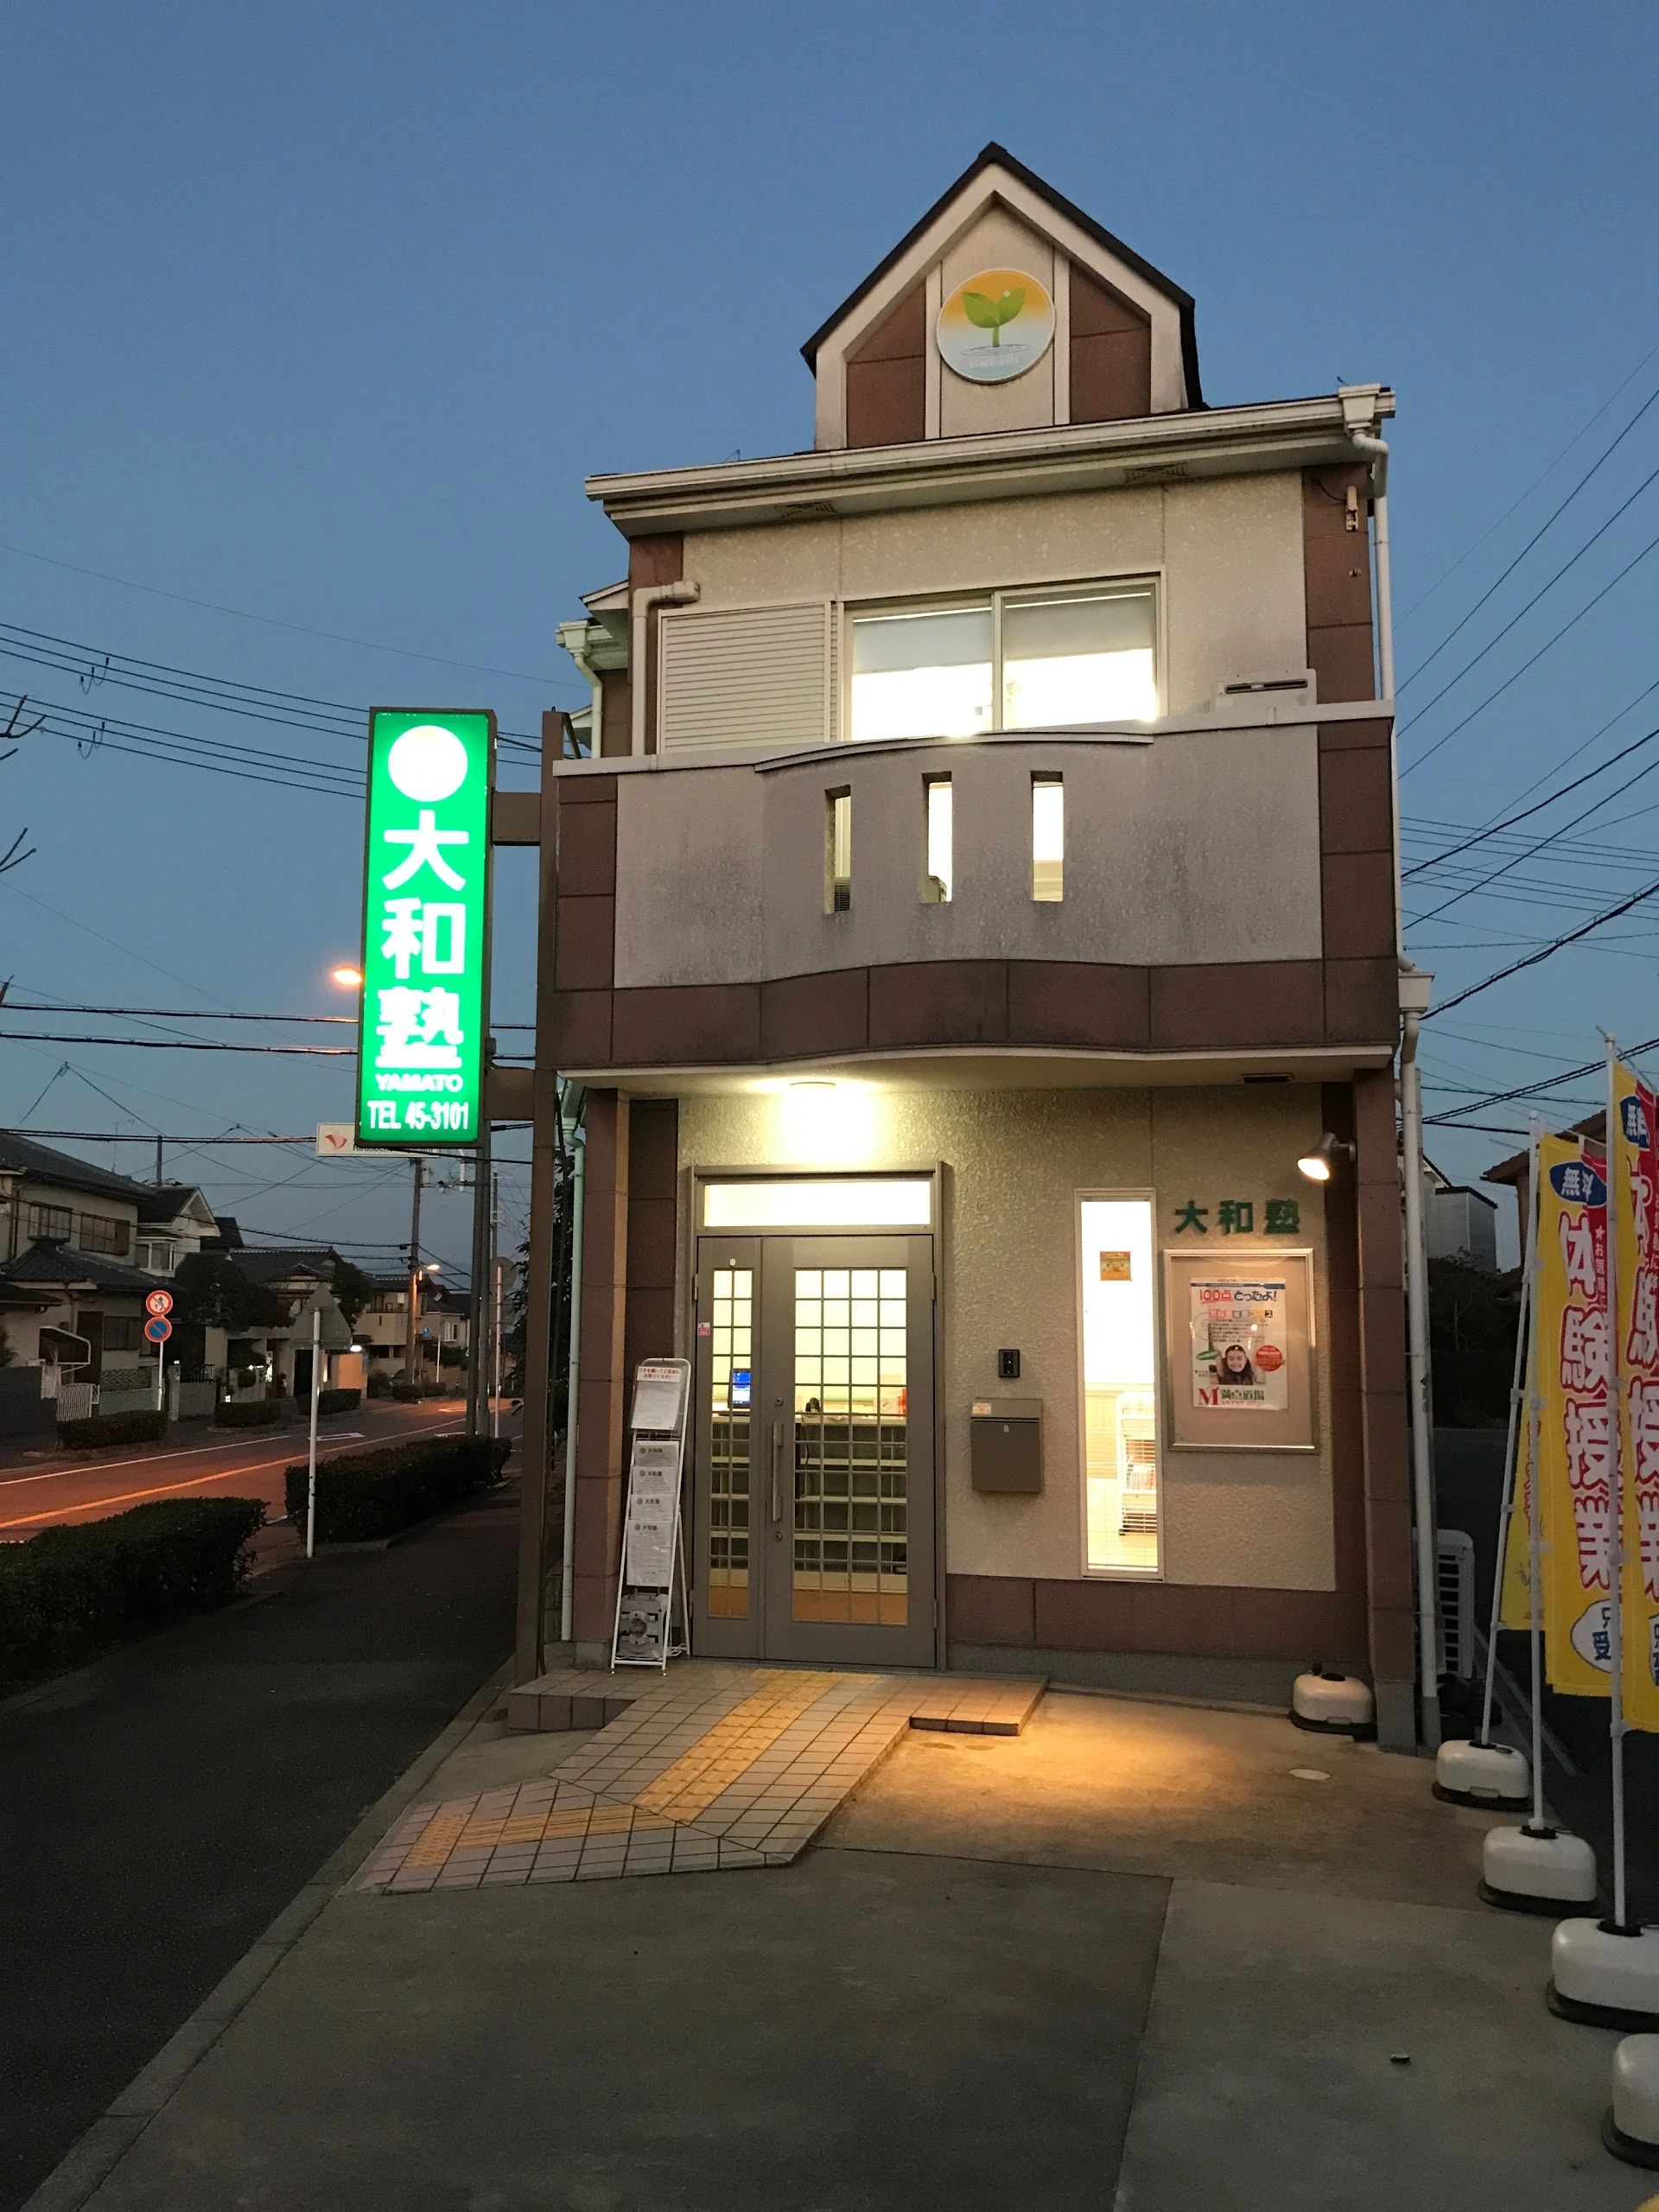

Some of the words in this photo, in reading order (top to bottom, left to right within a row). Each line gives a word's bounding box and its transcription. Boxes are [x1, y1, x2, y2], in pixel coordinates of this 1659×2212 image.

[375, 810, 469, 1070] 大和塾
[374, 1073, 464, 1093] YAMATO
[367, 1100, 402, 1130] TEL
[404, 1100, 469, 1131] 45-3101
[1174, 1198, 1300, 1235] 大和塾
